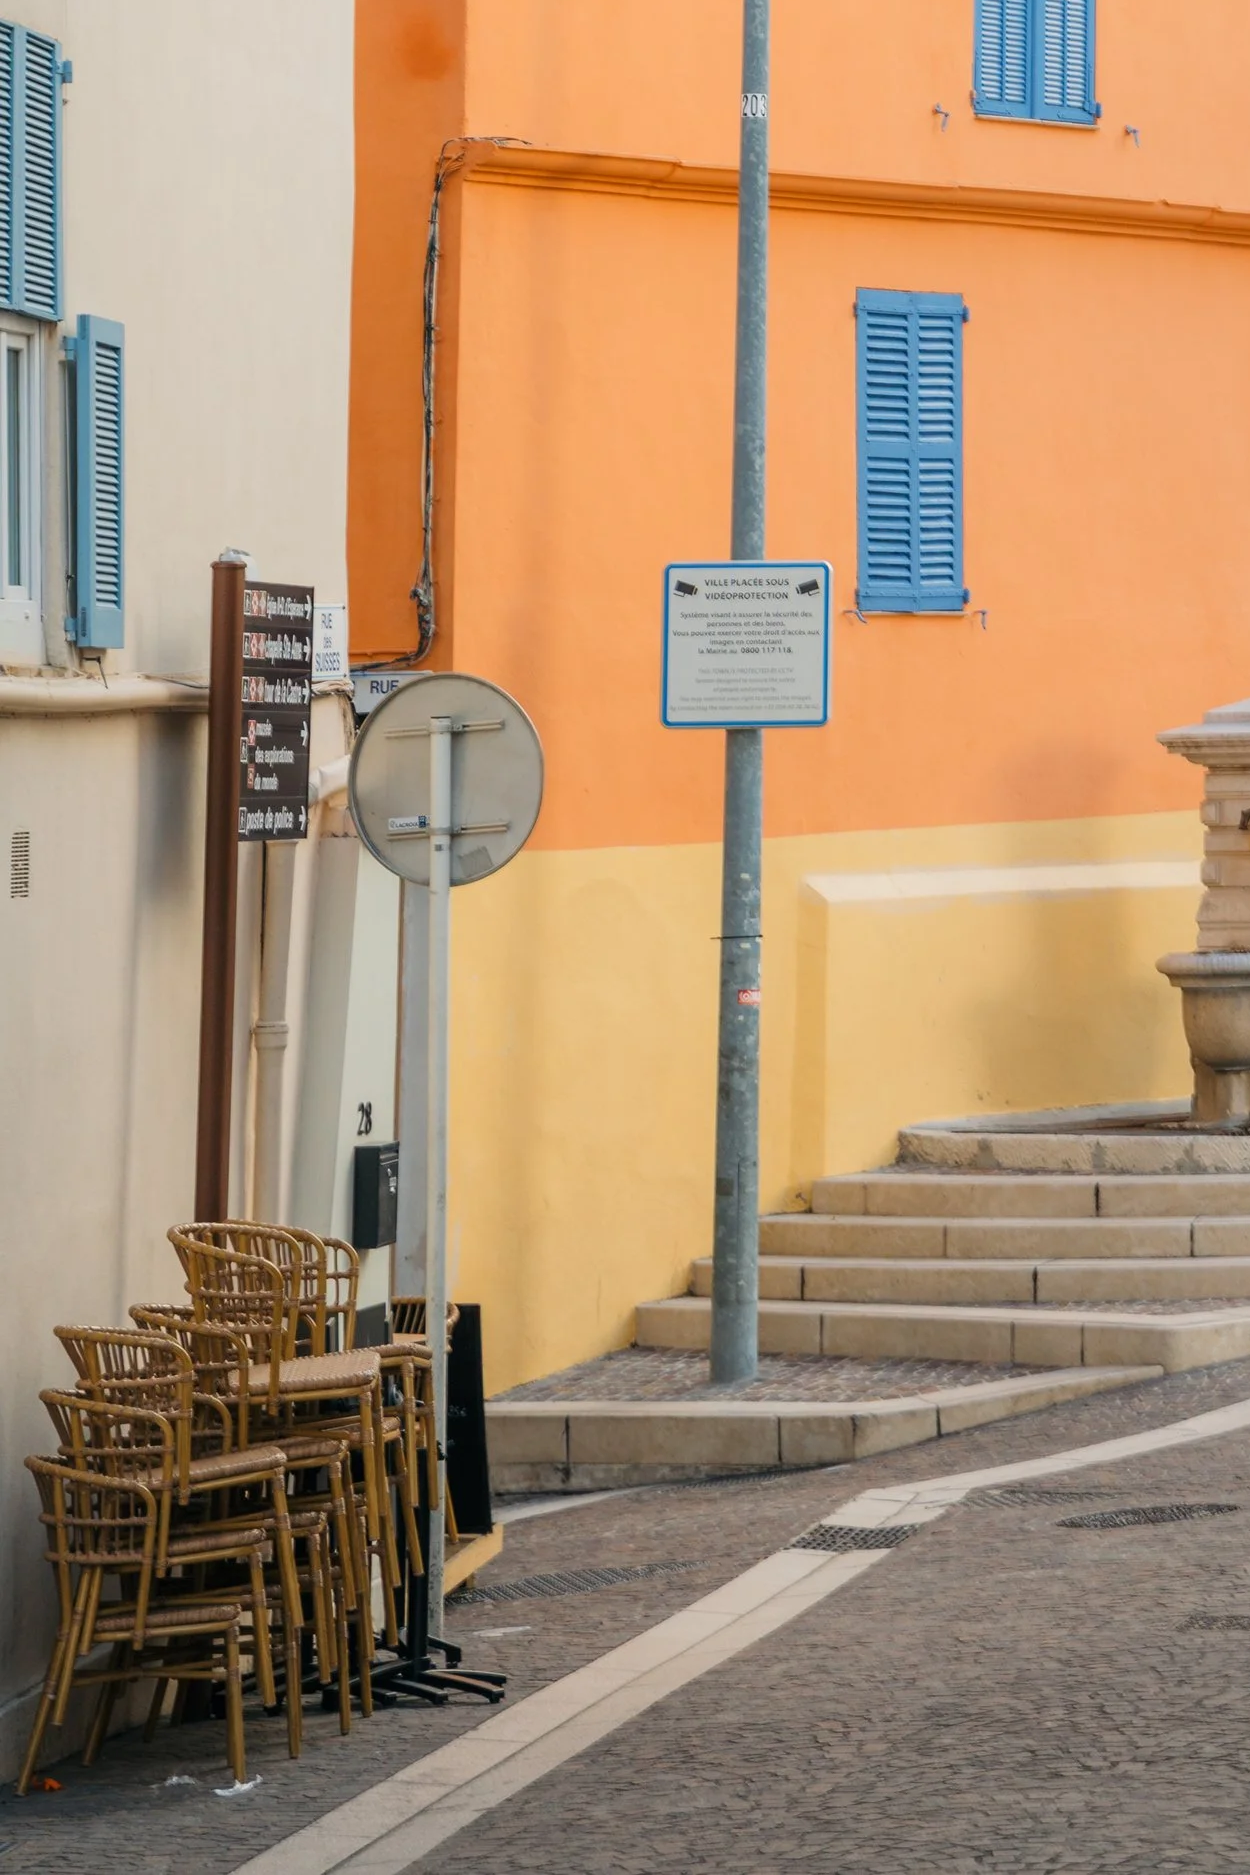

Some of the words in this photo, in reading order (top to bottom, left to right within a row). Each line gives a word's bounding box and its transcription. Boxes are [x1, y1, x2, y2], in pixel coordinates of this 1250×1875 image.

[742, 94, 767, 116] 203
[704, 579, 728, 587] VILLE
[731, 577, 763, 587] PLACÉE
[765, 578, 789, 586] SOUS
[705, 591, 789, 600] VIDÉOPROTECTION
[321, 612, 333, 629] RUE
[762, 628, 779, 636] droit
[315, 652, 341, 672] SUISSES
[245, 809, 264, 836] poste
[264, 806, 274, 829] de
[273, 806, 294, 836] police
[357, 1101, 372, 1136] 28
